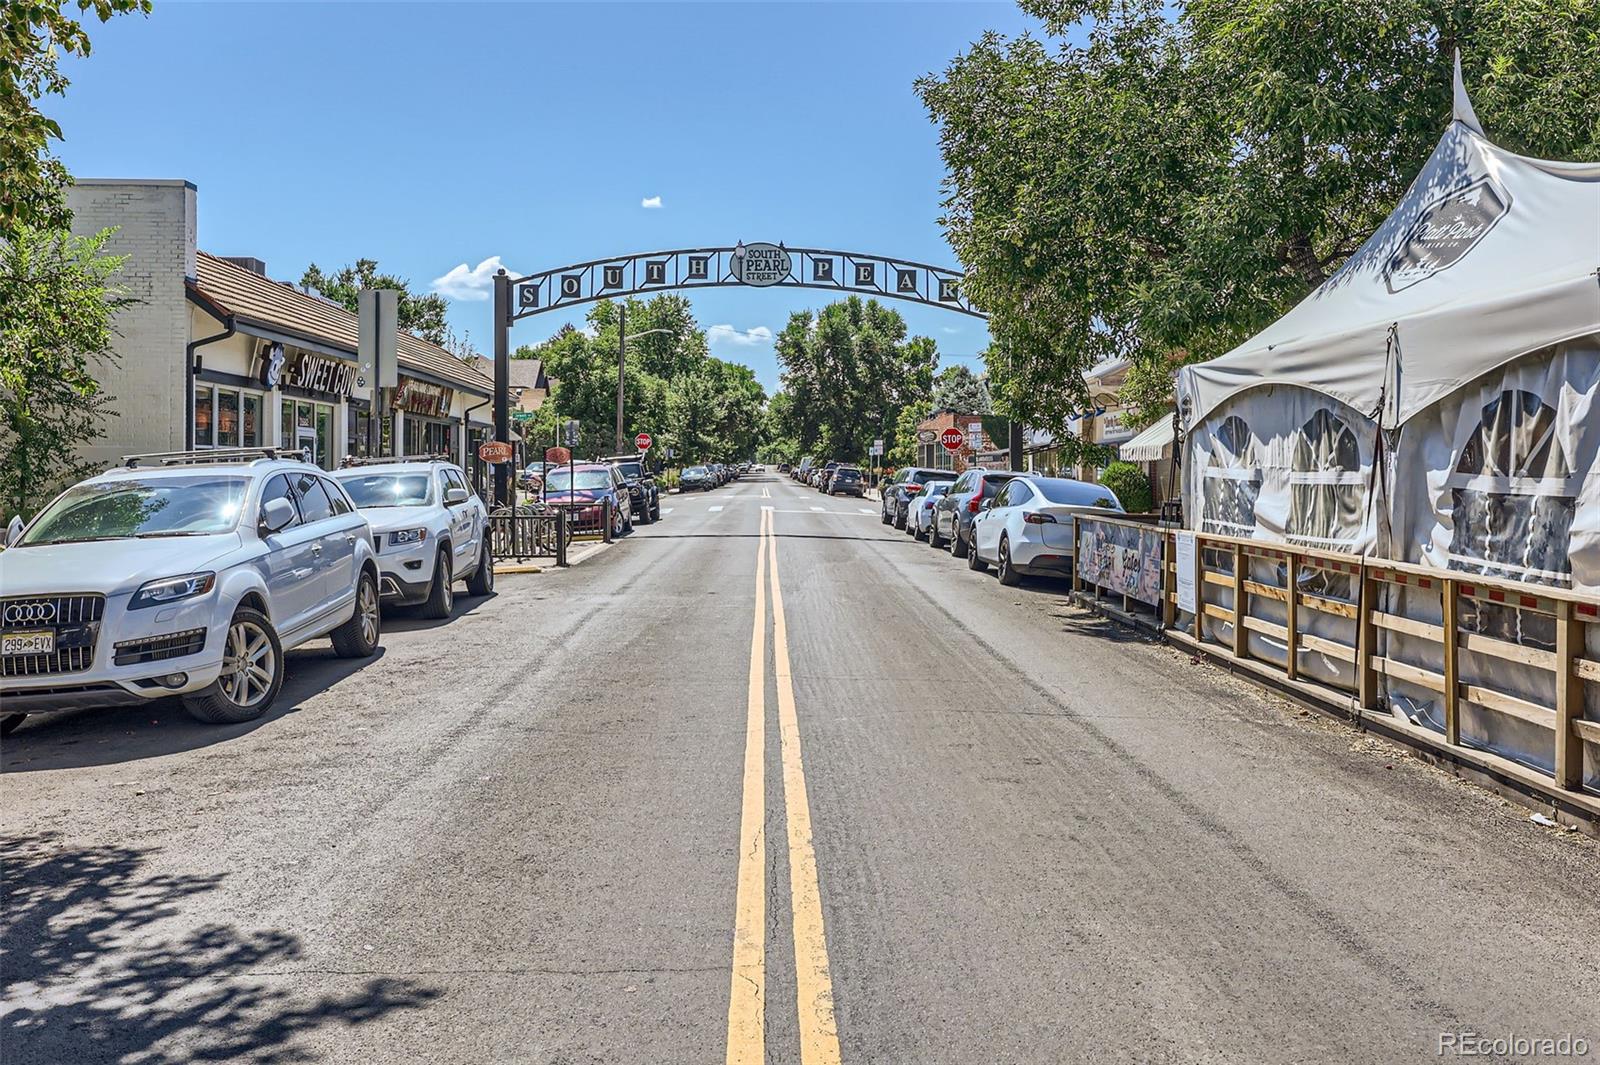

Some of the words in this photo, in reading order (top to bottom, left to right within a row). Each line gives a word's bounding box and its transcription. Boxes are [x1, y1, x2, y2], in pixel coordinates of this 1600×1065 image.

[1443, 221, 1484, 240] Park
[748, 250, 781, 259] SOUTH
[746, 259, 789, 276] PEARL
[523, 259, 708, 304] SOUTH
[746, 272, 778, 281] STREET
[298, 354, 336, 392] SWEET
[334, 363, 357, 396] COW
[635, 438, 651, 446] STOP
[942, 434, 962, 444] STOP
[483, 446, 509, 457] PEARL
[5, 638, 23, 651] 299
[34, 637, 52, 650] EVX
